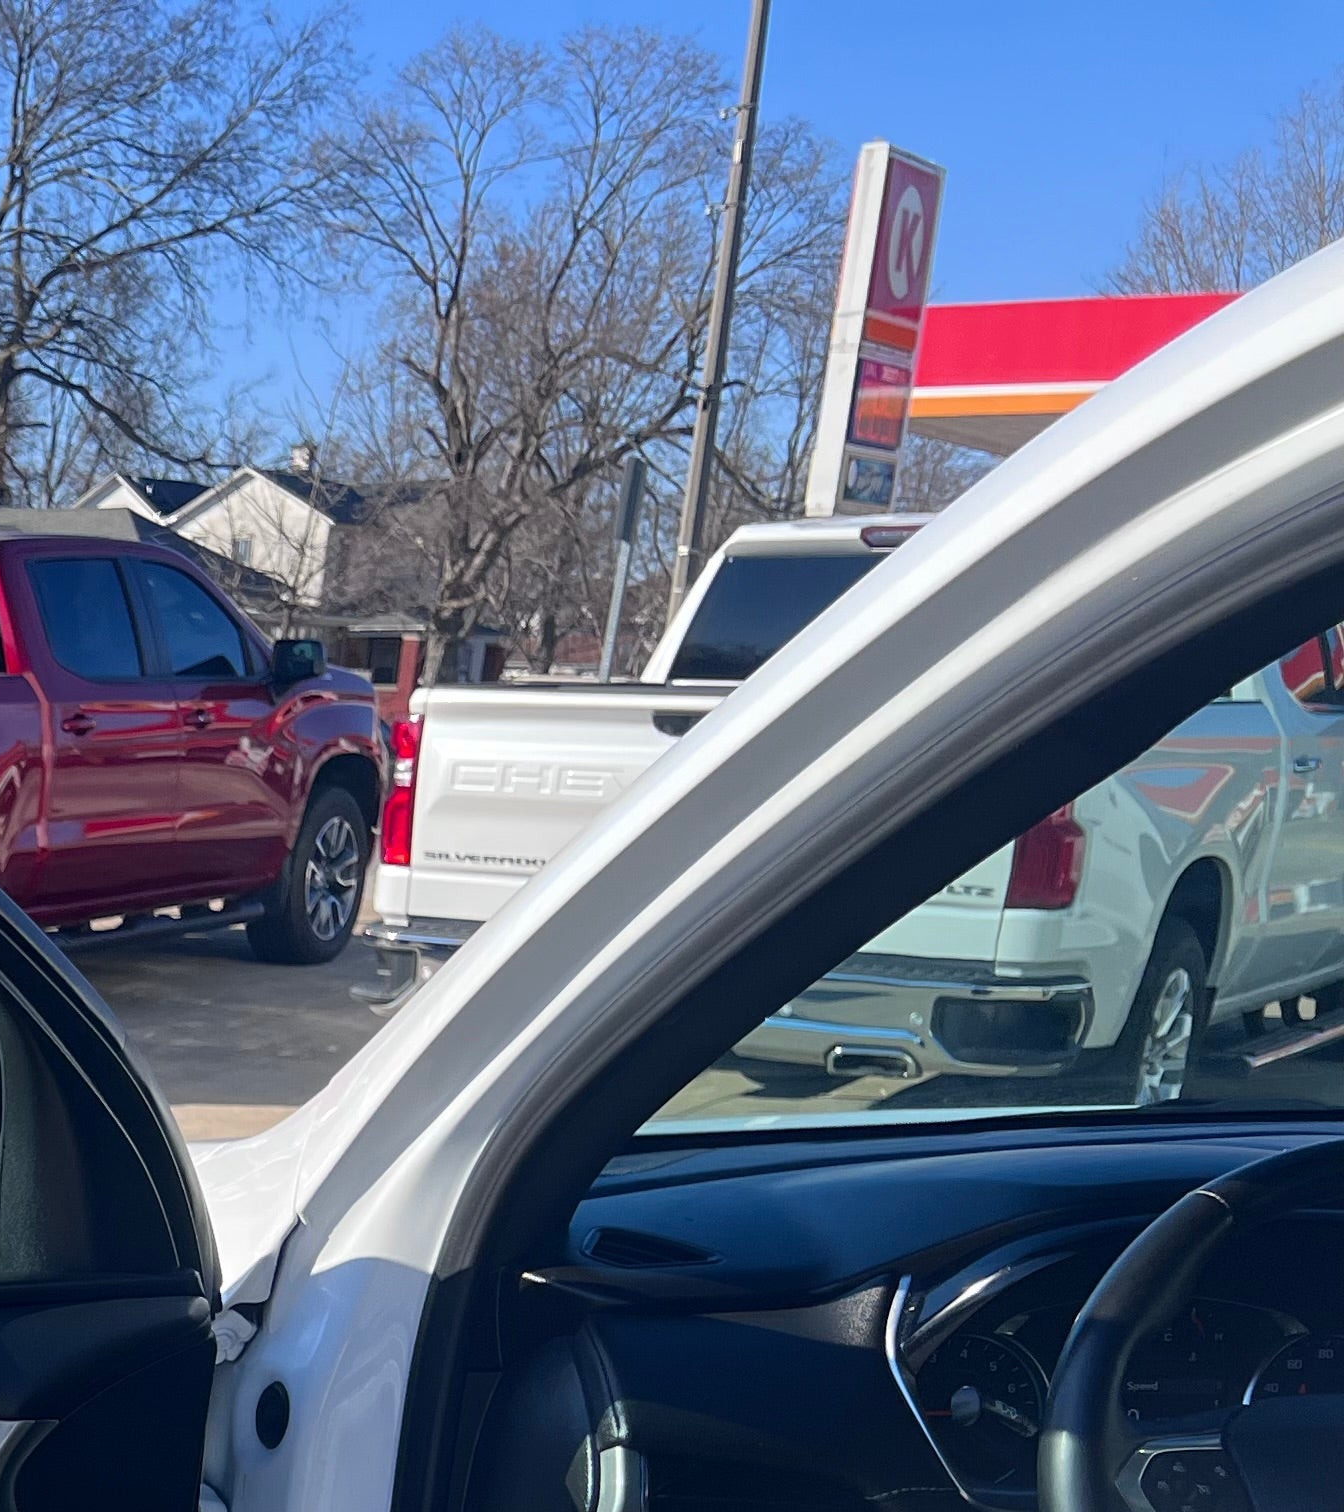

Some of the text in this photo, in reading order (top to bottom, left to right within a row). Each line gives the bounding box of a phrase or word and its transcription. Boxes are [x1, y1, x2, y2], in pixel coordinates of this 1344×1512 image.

[946, 884, 995, 898] LTZ
[989, 1362, 998, 1372] 5
[1007, 1383, 1016, 1393] 6
[1126, 1381, 1159, 1393] Speed
[1264, 1383, 1279, 1393] 40
